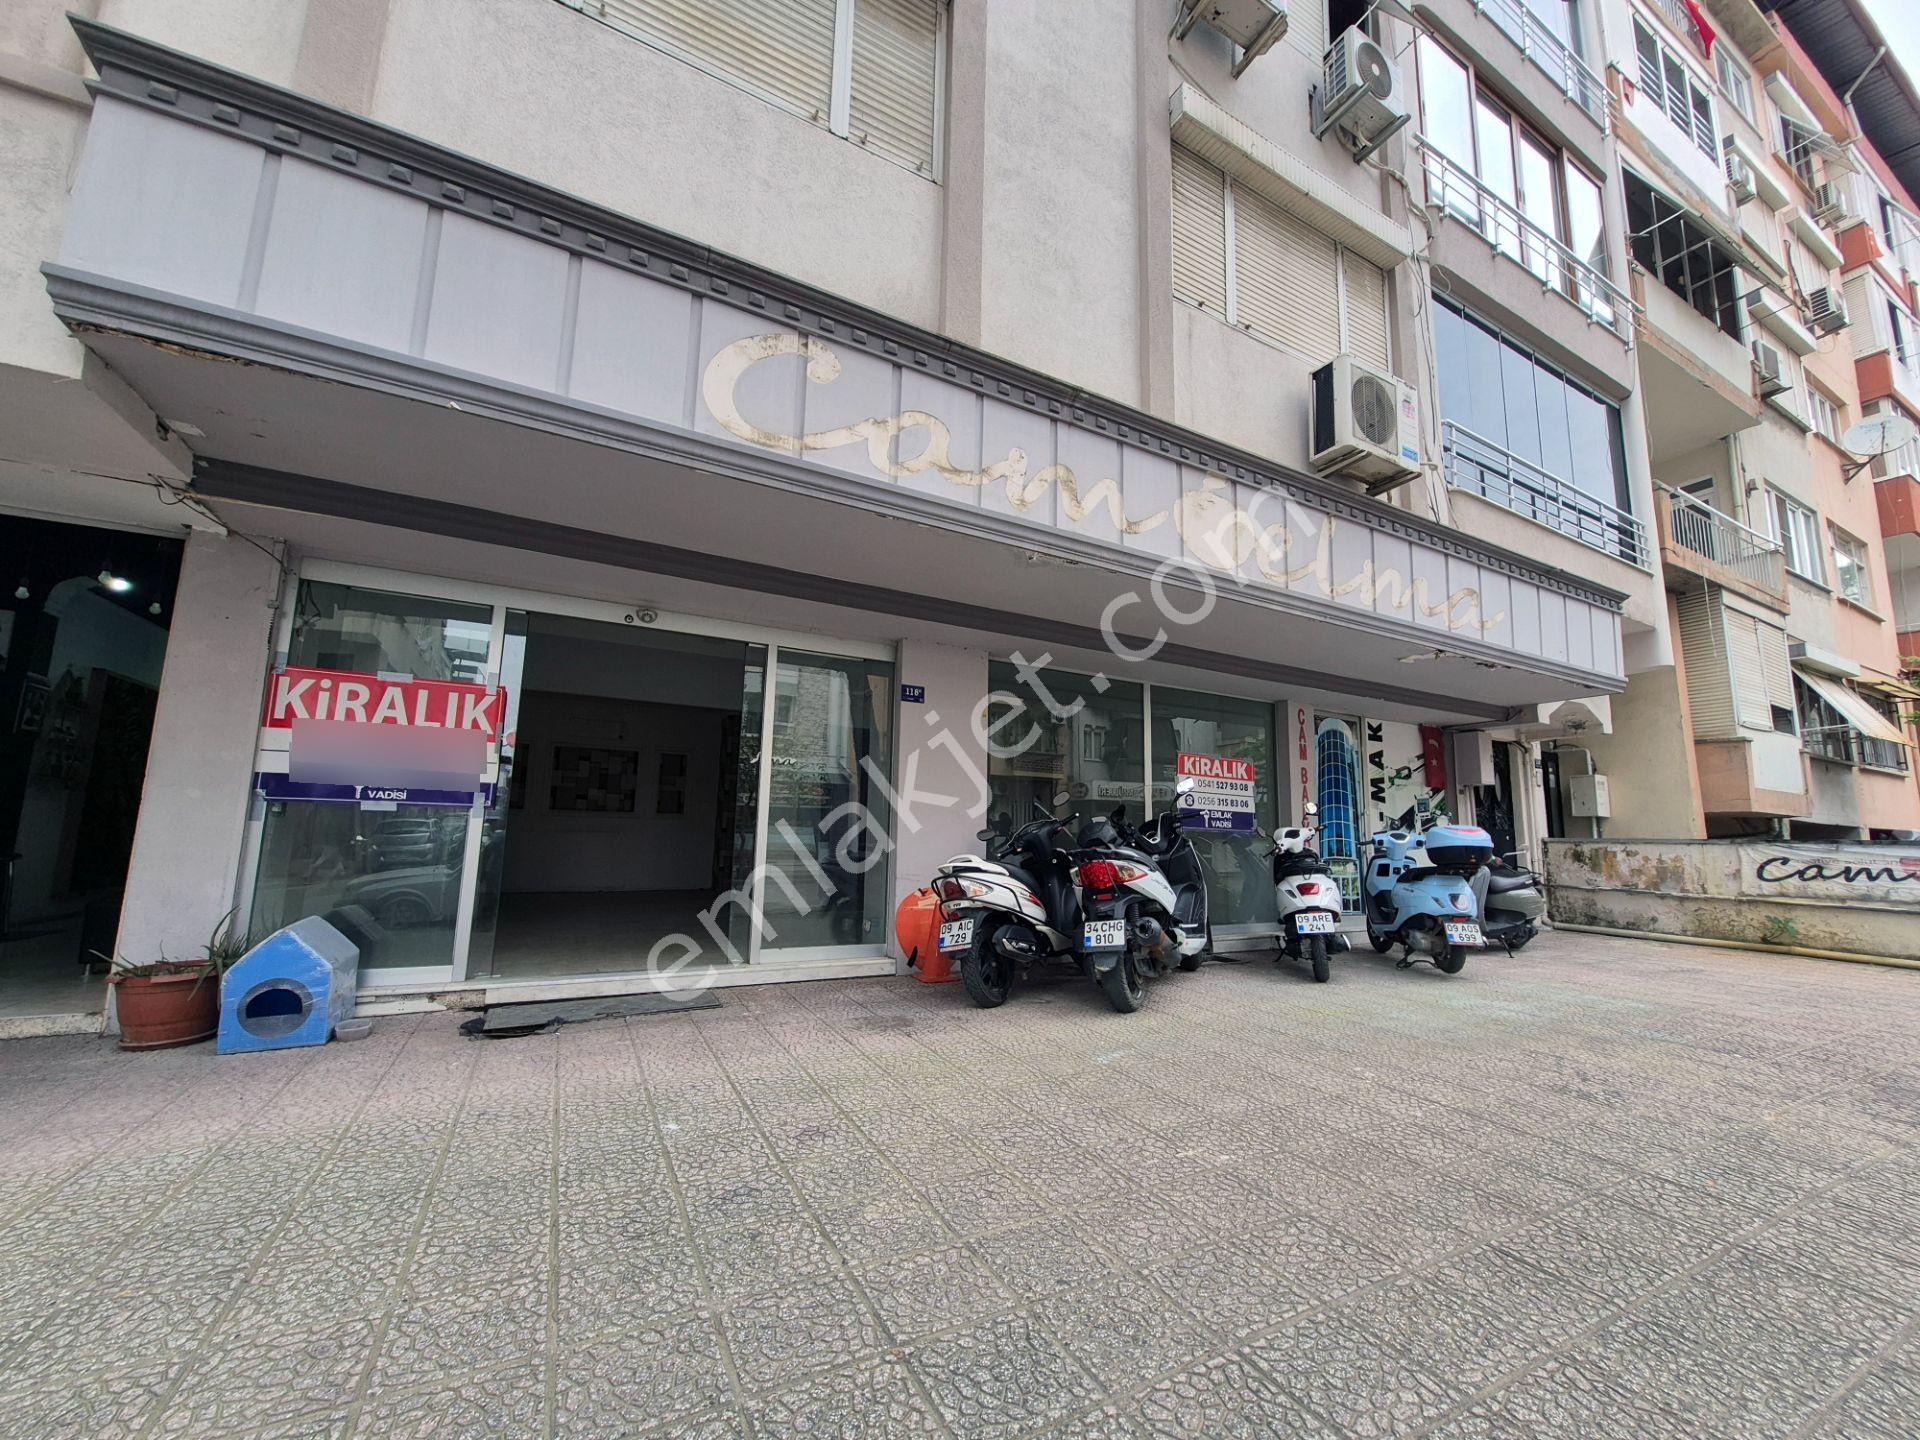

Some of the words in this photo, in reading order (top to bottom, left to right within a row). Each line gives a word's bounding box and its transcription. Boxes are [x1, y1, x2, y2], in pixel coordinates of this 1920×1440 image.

[1198, 779, 1214, 788] 0541
[1216, 782, 1228, 790] 527
[1229, 783, 1238, 791] 93
[1239, 783, 1249, 792] 08
[1198, 796, 1215, 806] 0256
[1217, 798, 1229, 807] 315
[1240, 800, 1249, 808] 06
[1211, 811, 1232, 819] EMLAK
[1756, 856, 1917, 882] Cam
[1297, 915, 1309, 923] 09
[941, 923, 953, 934] 09
[957, 920, 973, 932] AIC
[1086, 923, 1099, 933] 34
[1100, 921, 1123, 932] CHG
[949, 932, 967, 944] 729
[1095, 933, 1114, 944] 810
